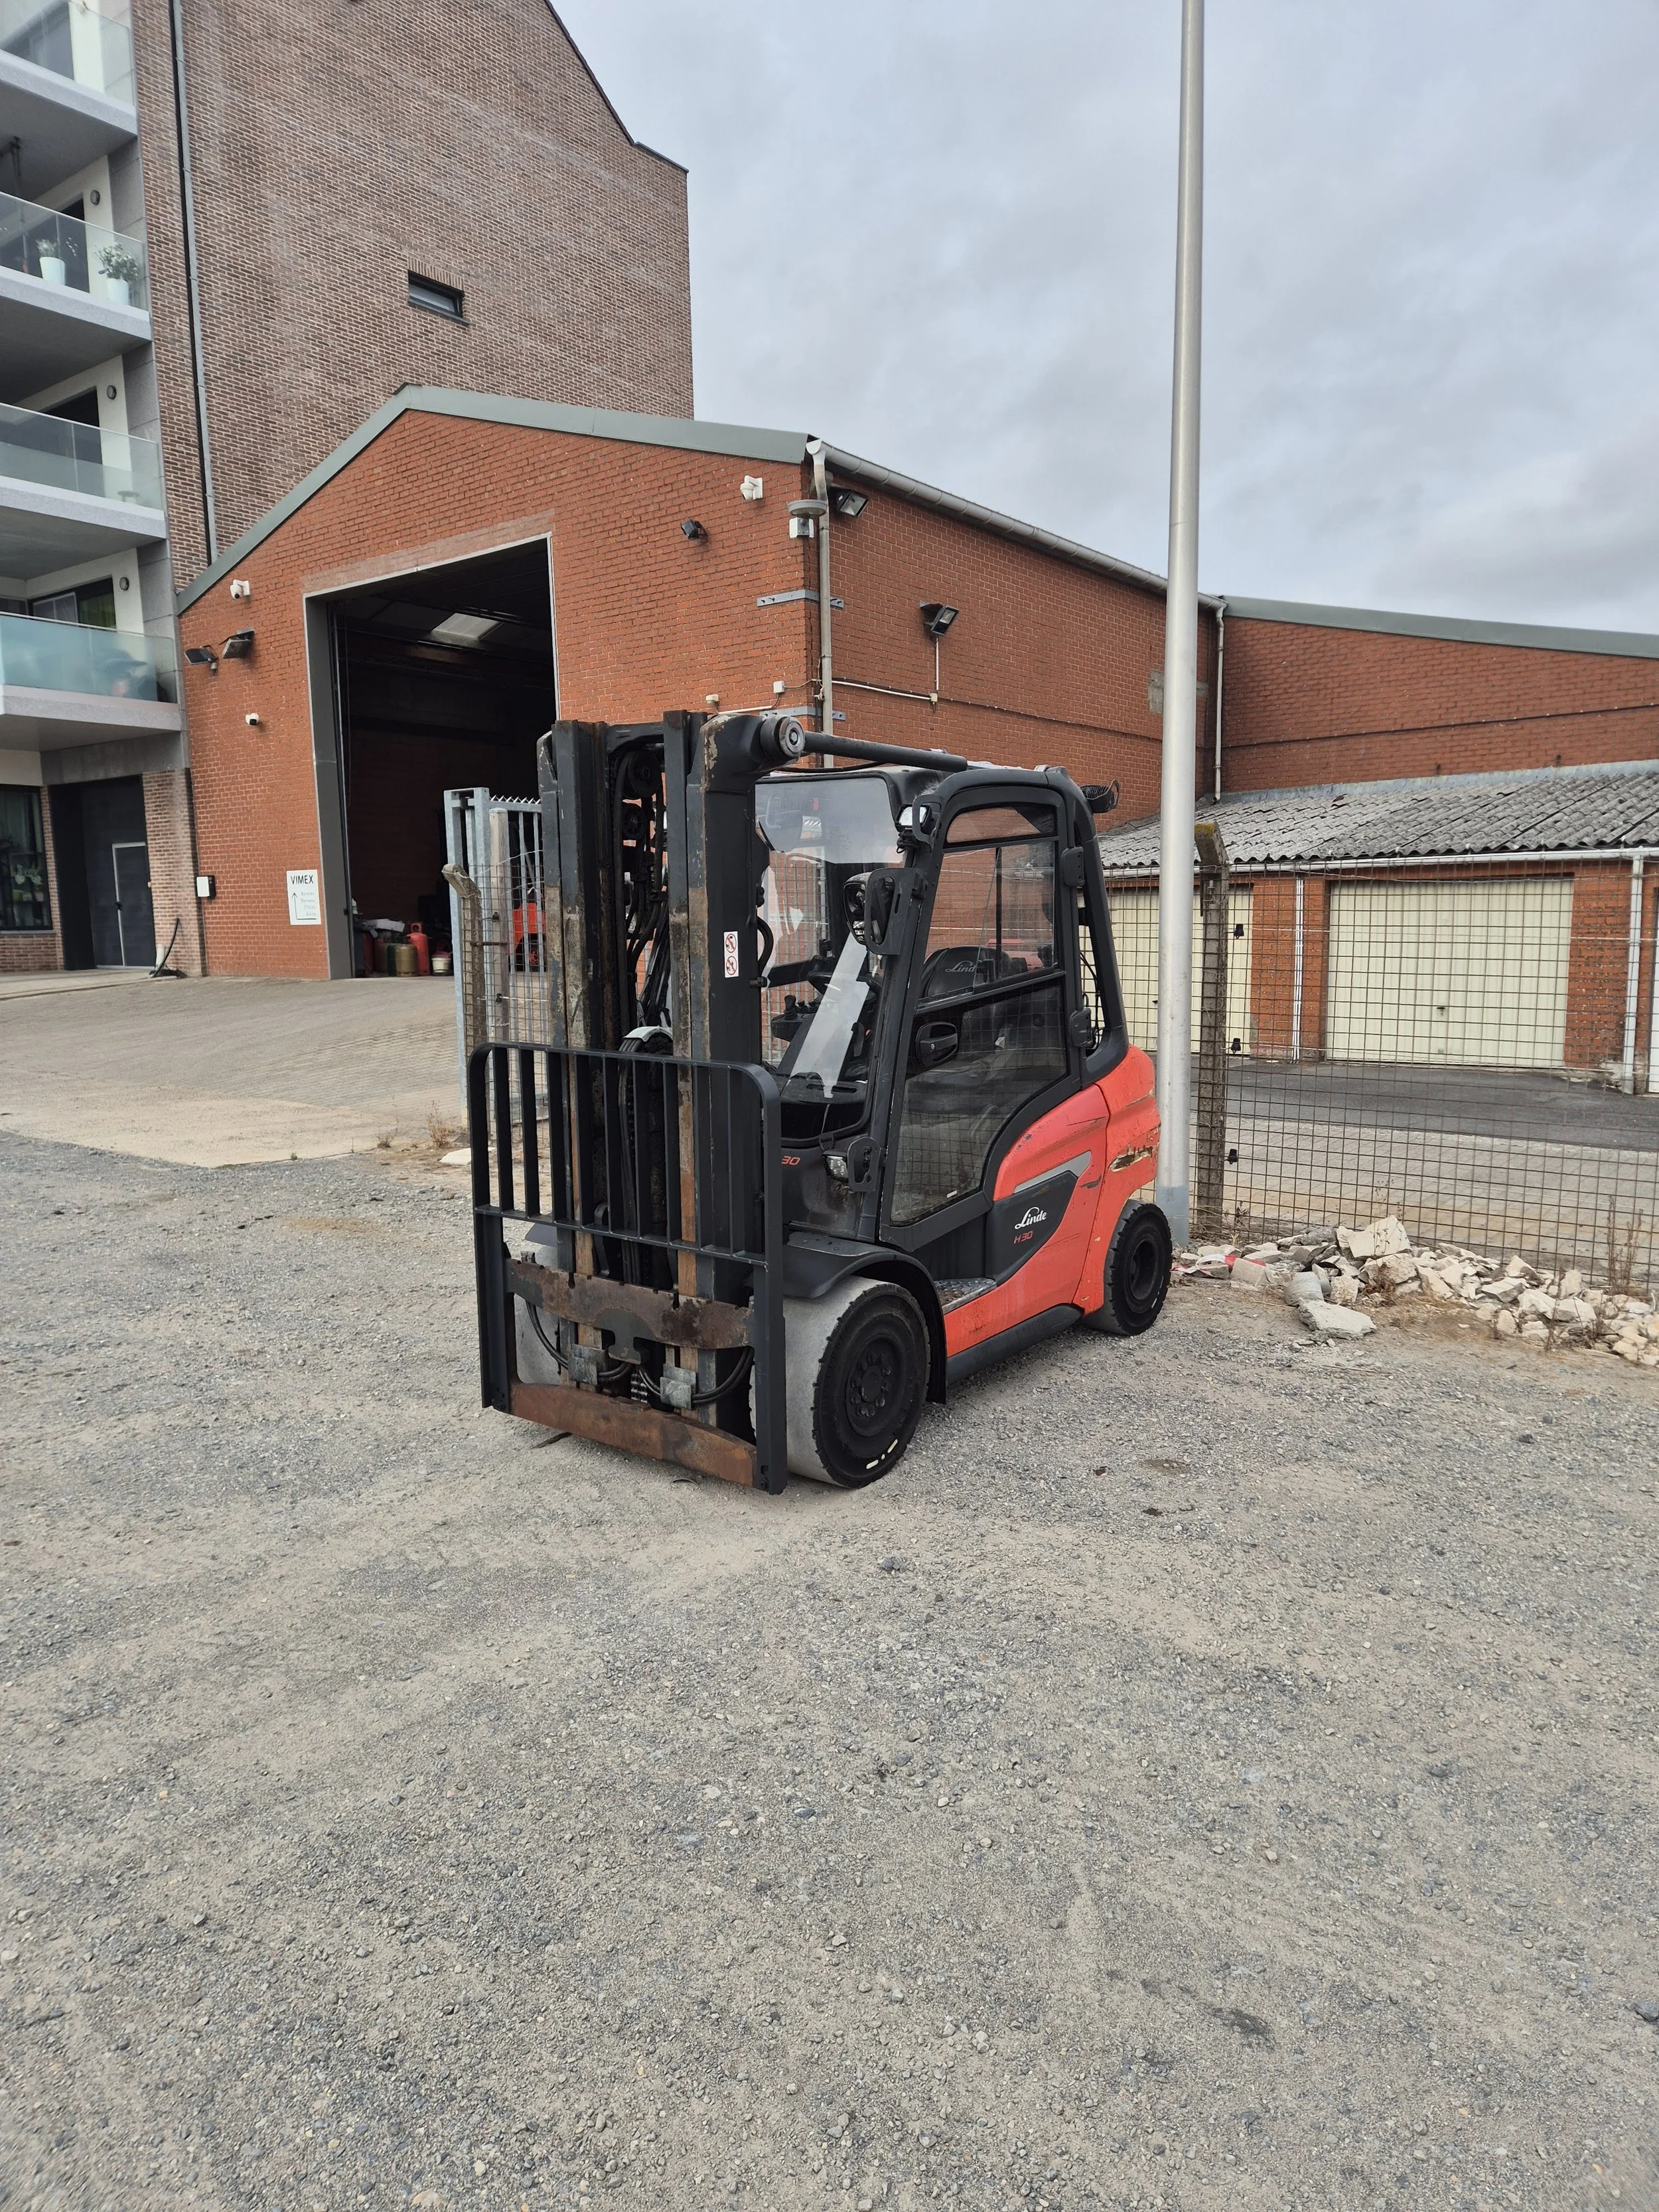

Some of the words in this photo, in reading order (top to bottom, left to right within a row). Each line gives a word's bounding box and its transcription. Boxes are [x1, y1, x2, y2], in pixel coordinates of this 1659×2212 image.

[291, 875, 314, 885] VIMEX
[945, 960, 977, 973] Lind
[781, 1155, 801, 1165] 30
[1014, 1207, 1047, 1230] Linde
[1013, 1230, 1033, 1244] H30
